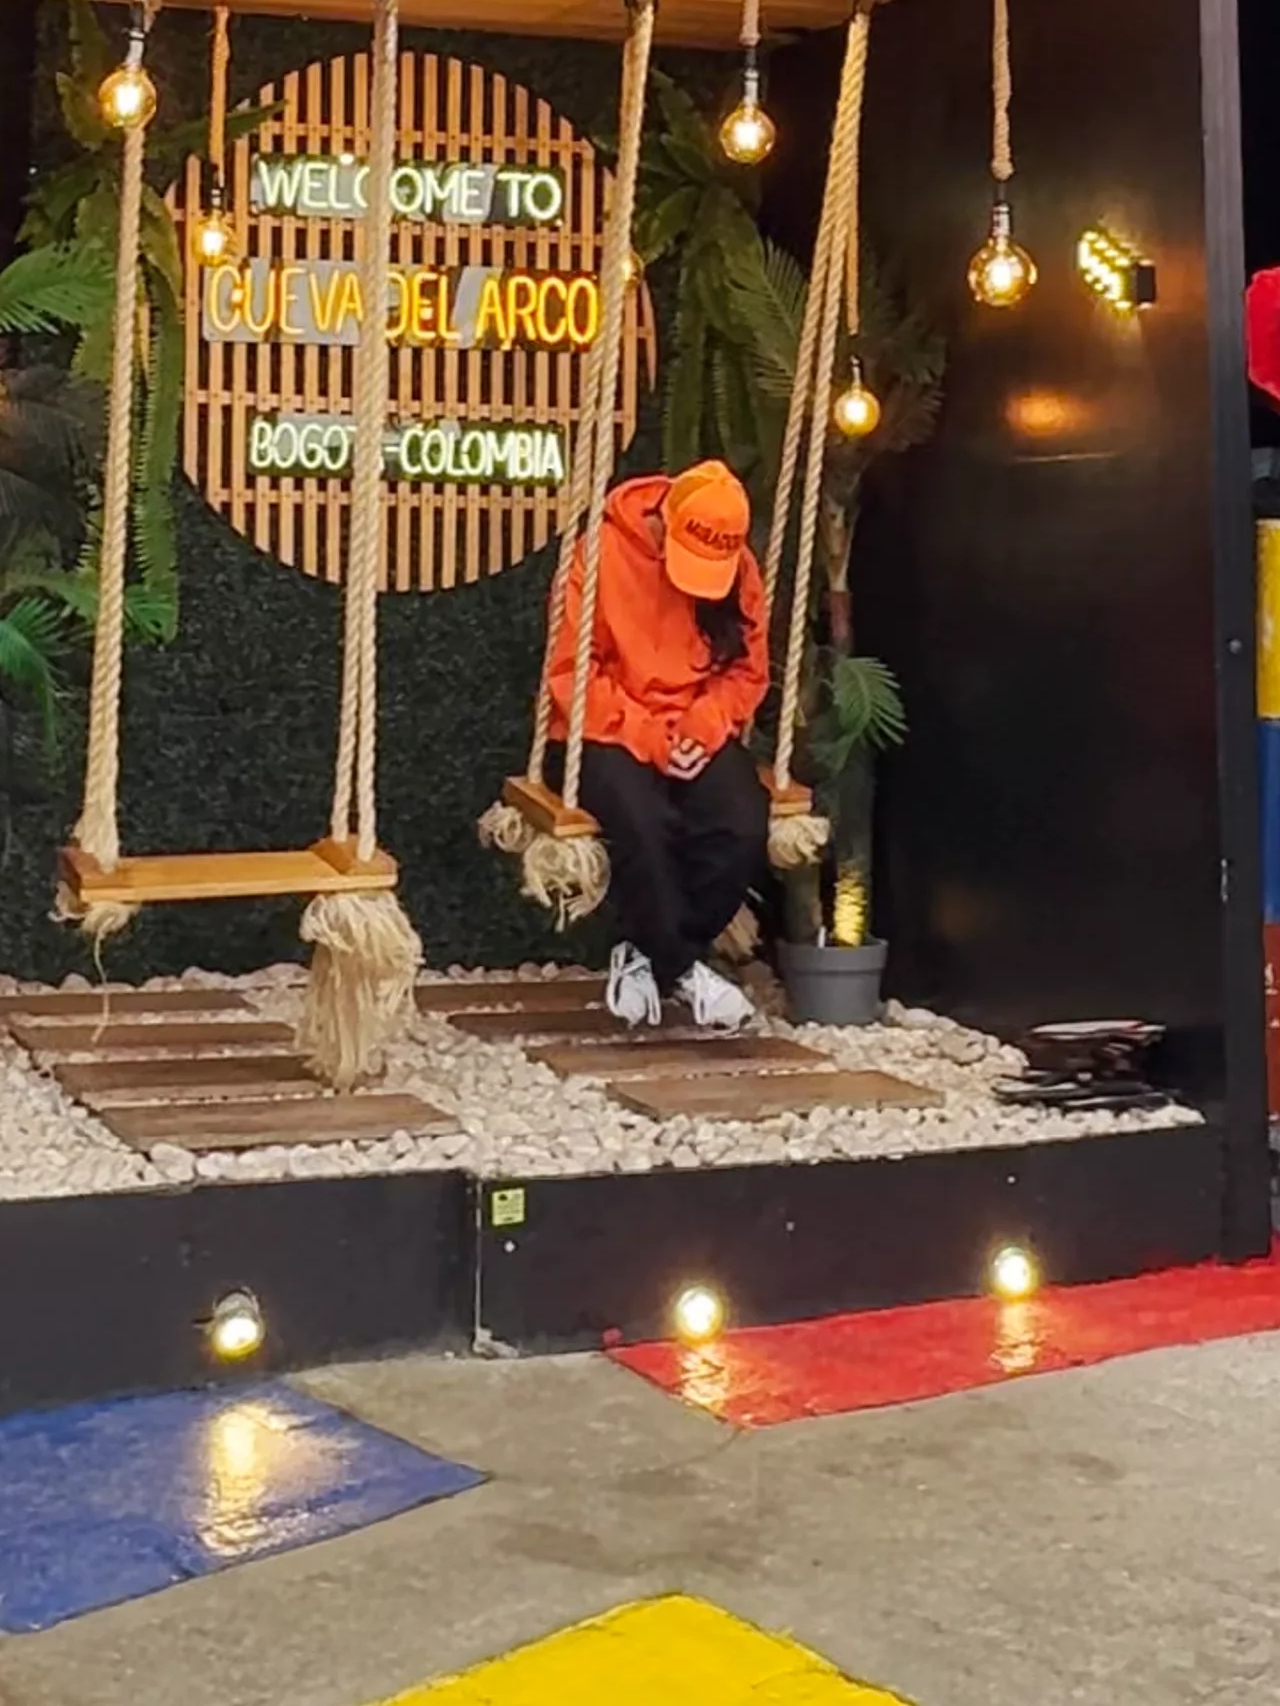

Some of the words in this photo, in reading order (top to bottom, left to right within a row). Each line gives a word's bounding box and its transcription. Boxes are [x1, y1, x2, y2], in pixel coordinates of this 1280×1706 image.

[257, 160, 485, 219] WELCOME
[499, 170, 562, 221] TO
[208, 265, 365, 337] CUEVA
[386, 271, 462, 343] DEL
[475, 275, 599, 344] ARCO
